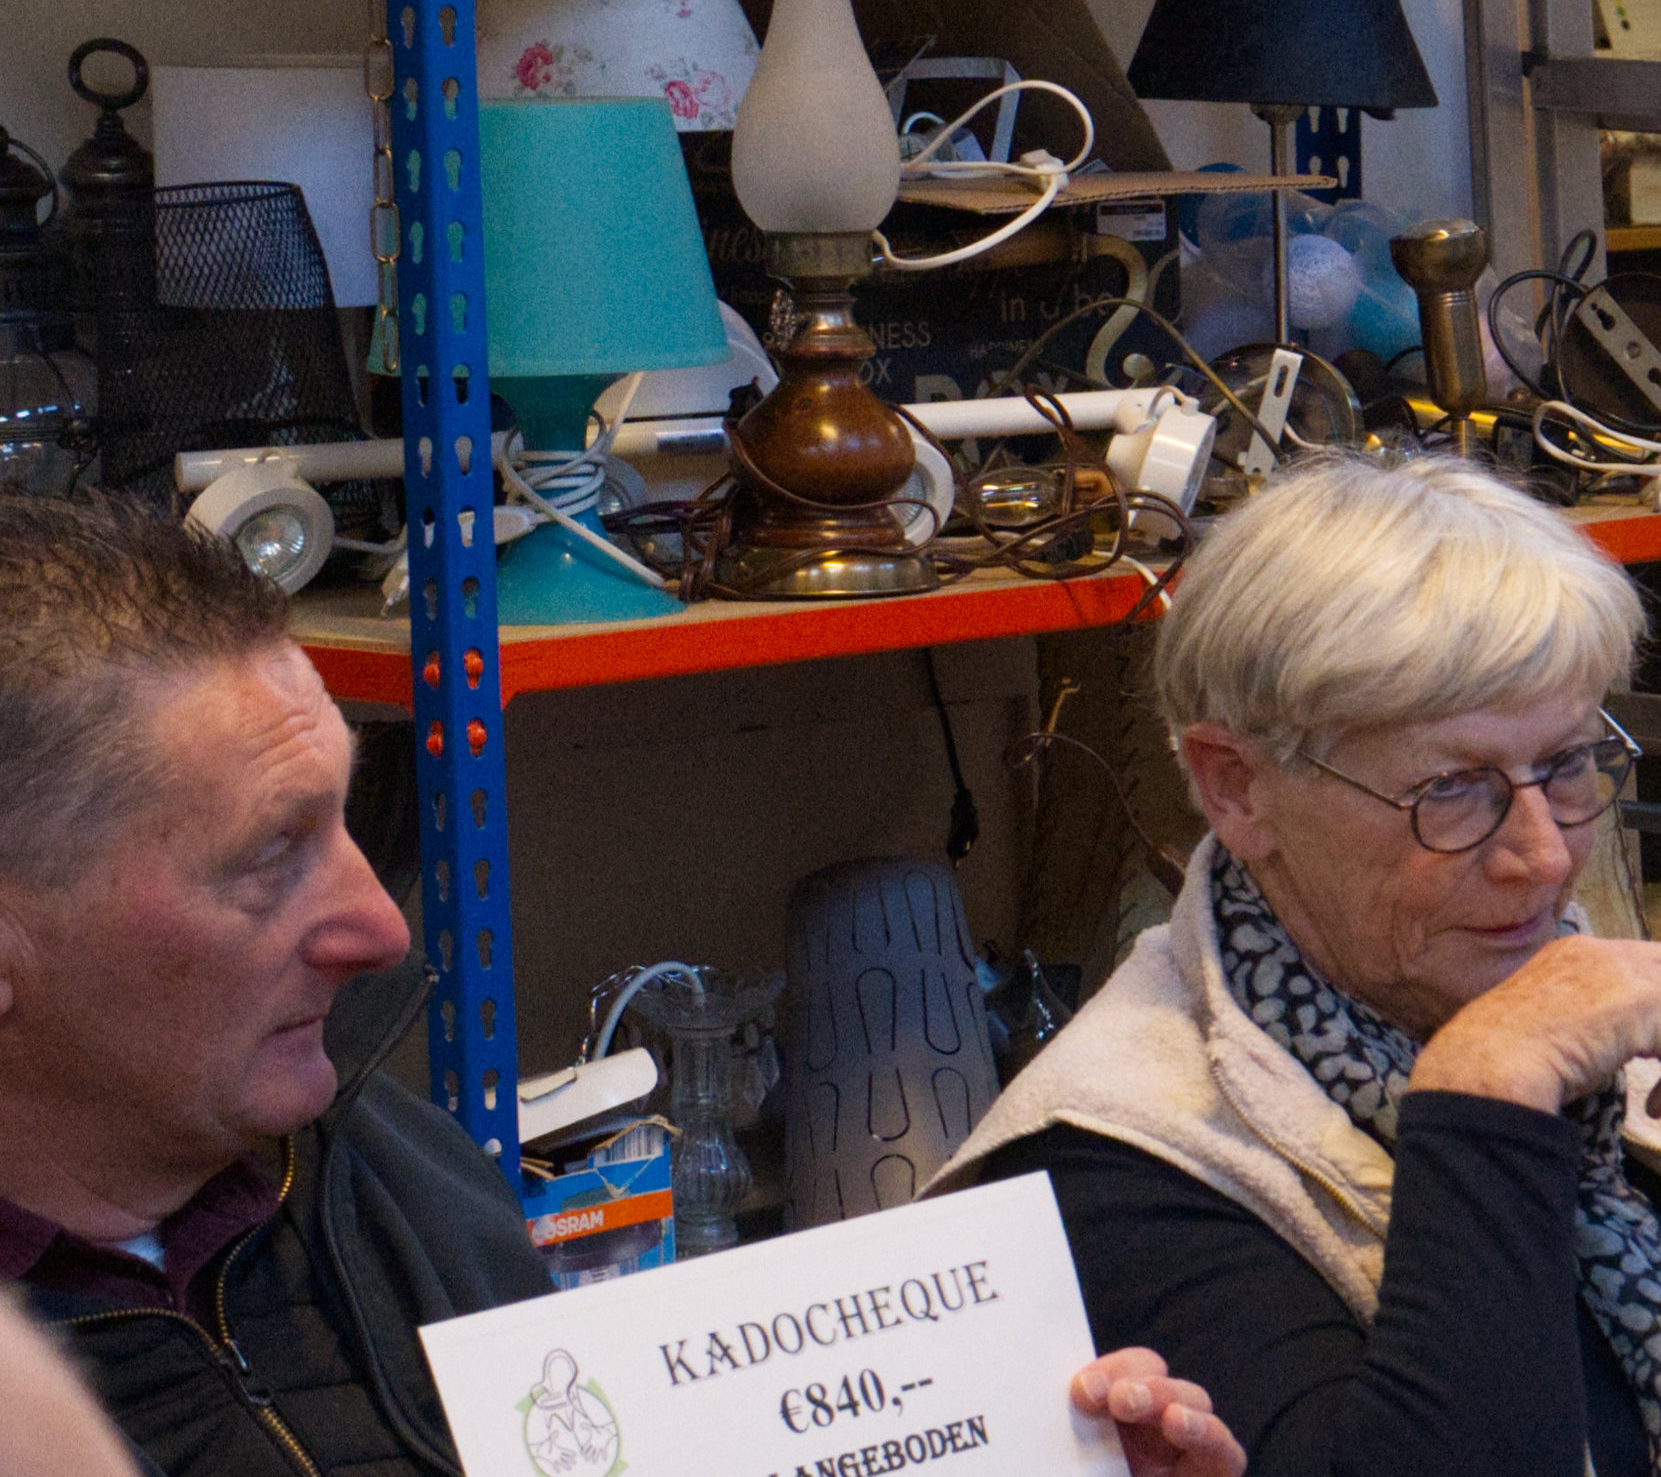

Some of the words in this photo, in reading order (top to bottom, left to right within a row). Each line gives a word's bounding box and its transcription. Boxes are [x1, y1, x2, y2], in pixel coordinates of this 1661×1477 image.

[545, 1209, 605, 1240] OSRAM
[657, 1257, 1001, 1389] KADOCHEQUE
[777, 1365, 937, 1437] €840,--
